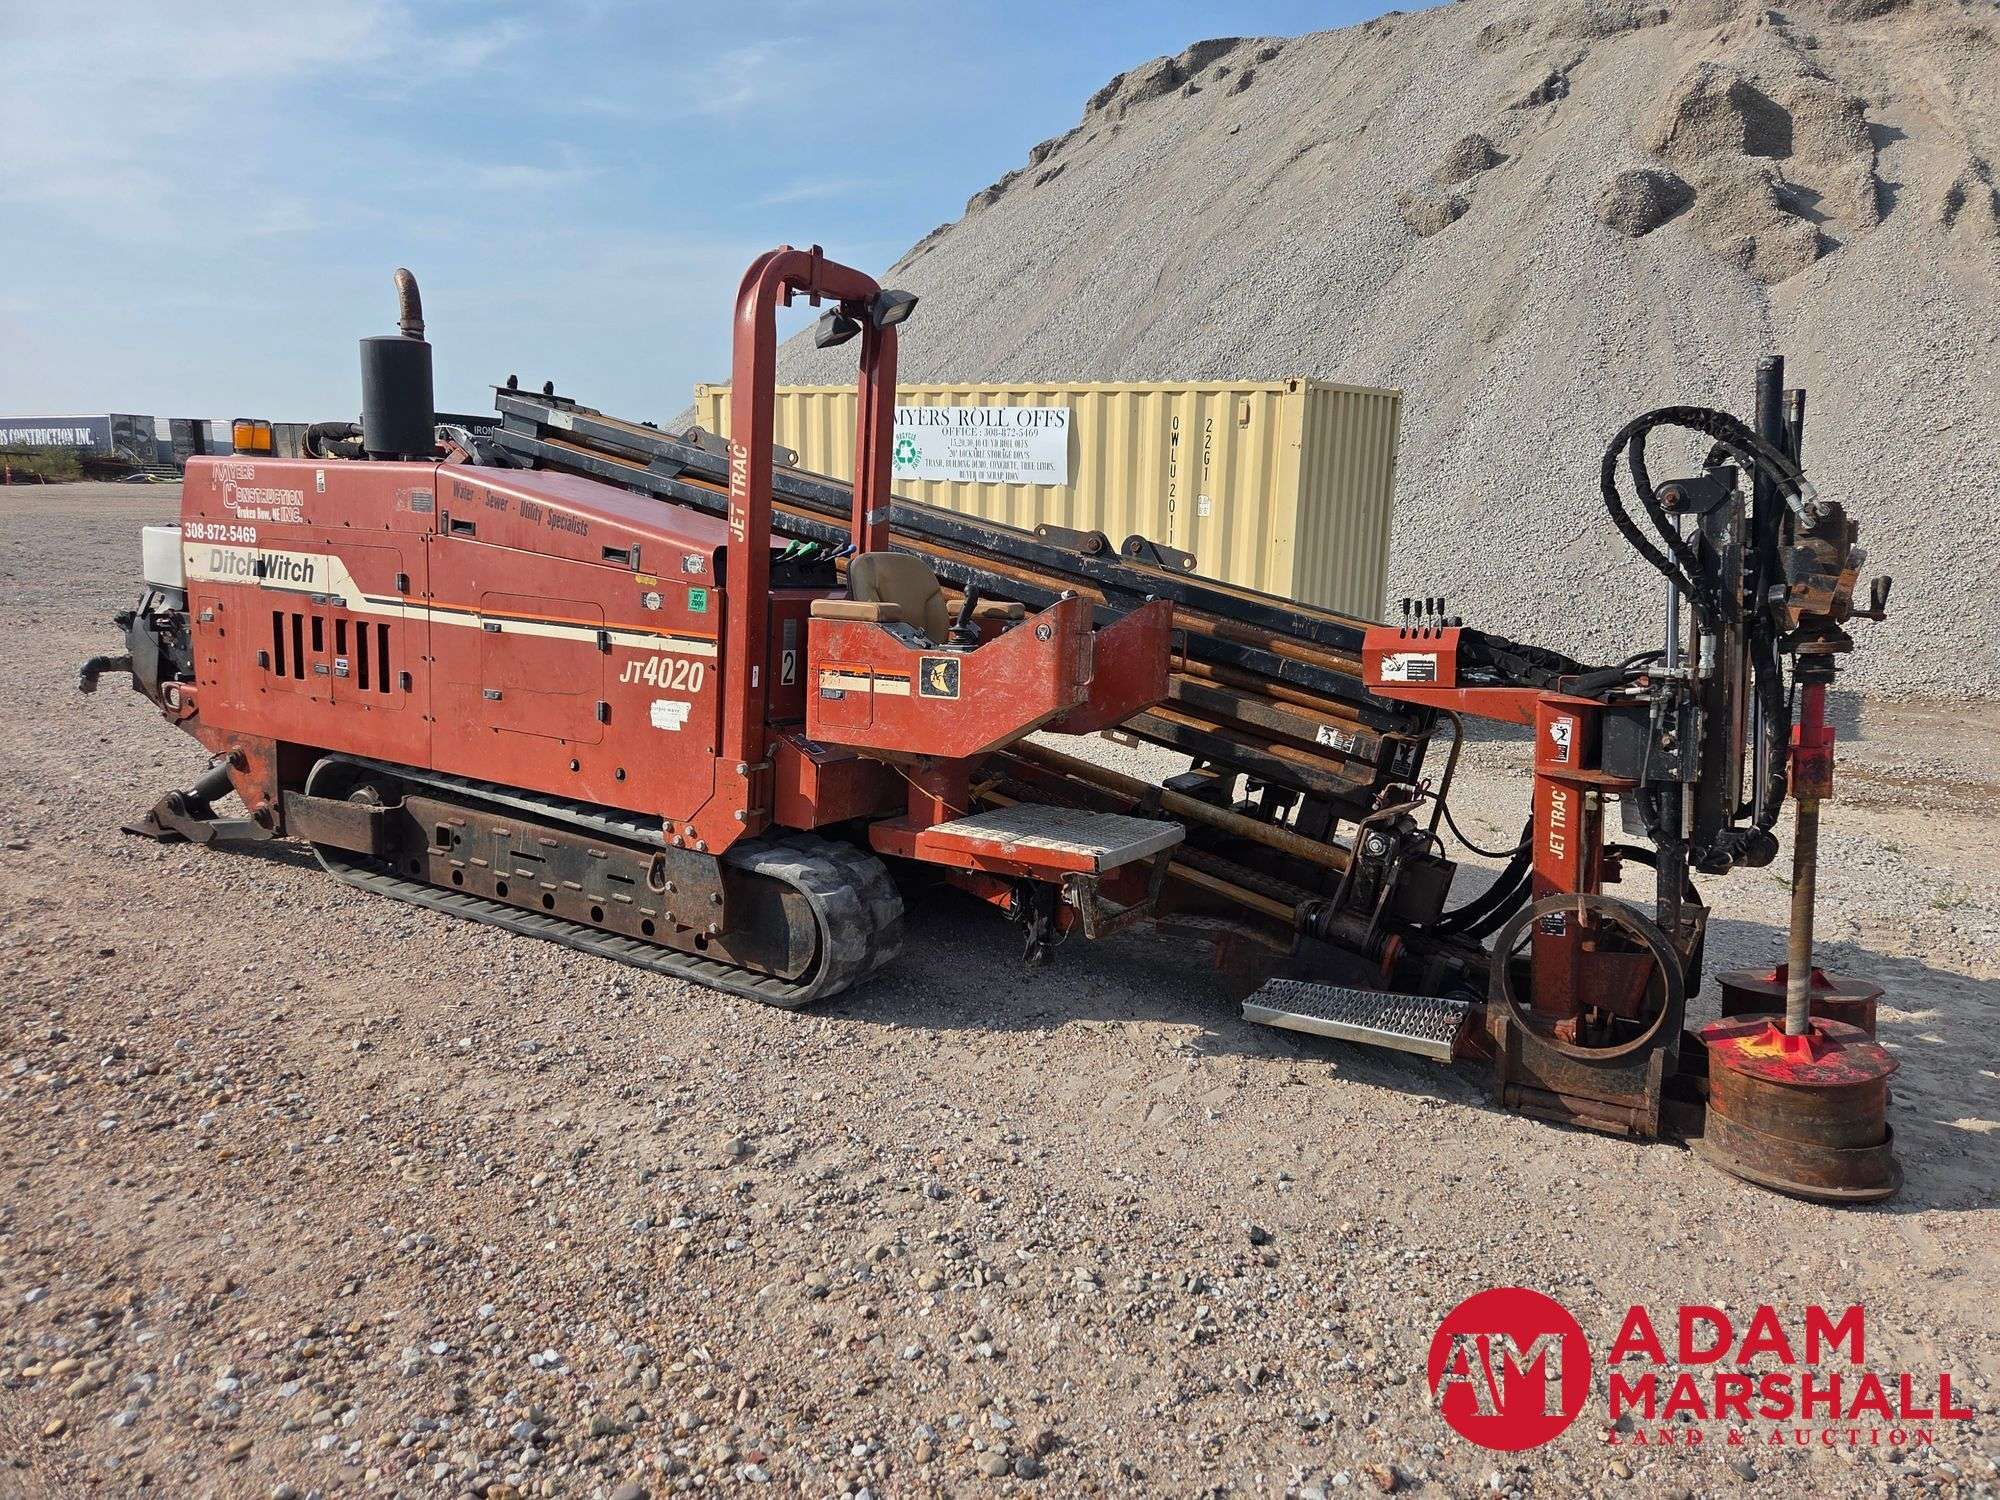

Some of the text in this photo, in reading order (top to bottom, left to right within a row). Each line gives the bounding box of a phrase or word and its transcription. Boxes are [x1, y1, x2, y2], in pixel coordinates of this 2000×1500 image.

[959, 409, 1009, 427] ROLL
[1017, 410, 1065, 427] OFFS
[984, 427, 1039, 437] 308-872-5469
[9, 428, 73, 445] CONSTRUCTION
[75, 428, 94, 445] INC.
[1203, 418, 1213, 481] 22G1
[453, 480, 589, 537] Water Sewer Utility Specialists
[730, 446, 748, 543] JET TRAC
[184, 522, 256, 543] 308-872-5469
[209, 548, 314, 584] Ditch Witch
[619, 656, 705, 693] JT4020
[783, 651, 794, 684] 2
[1550, 791, 1568, 860] JET TRAC
